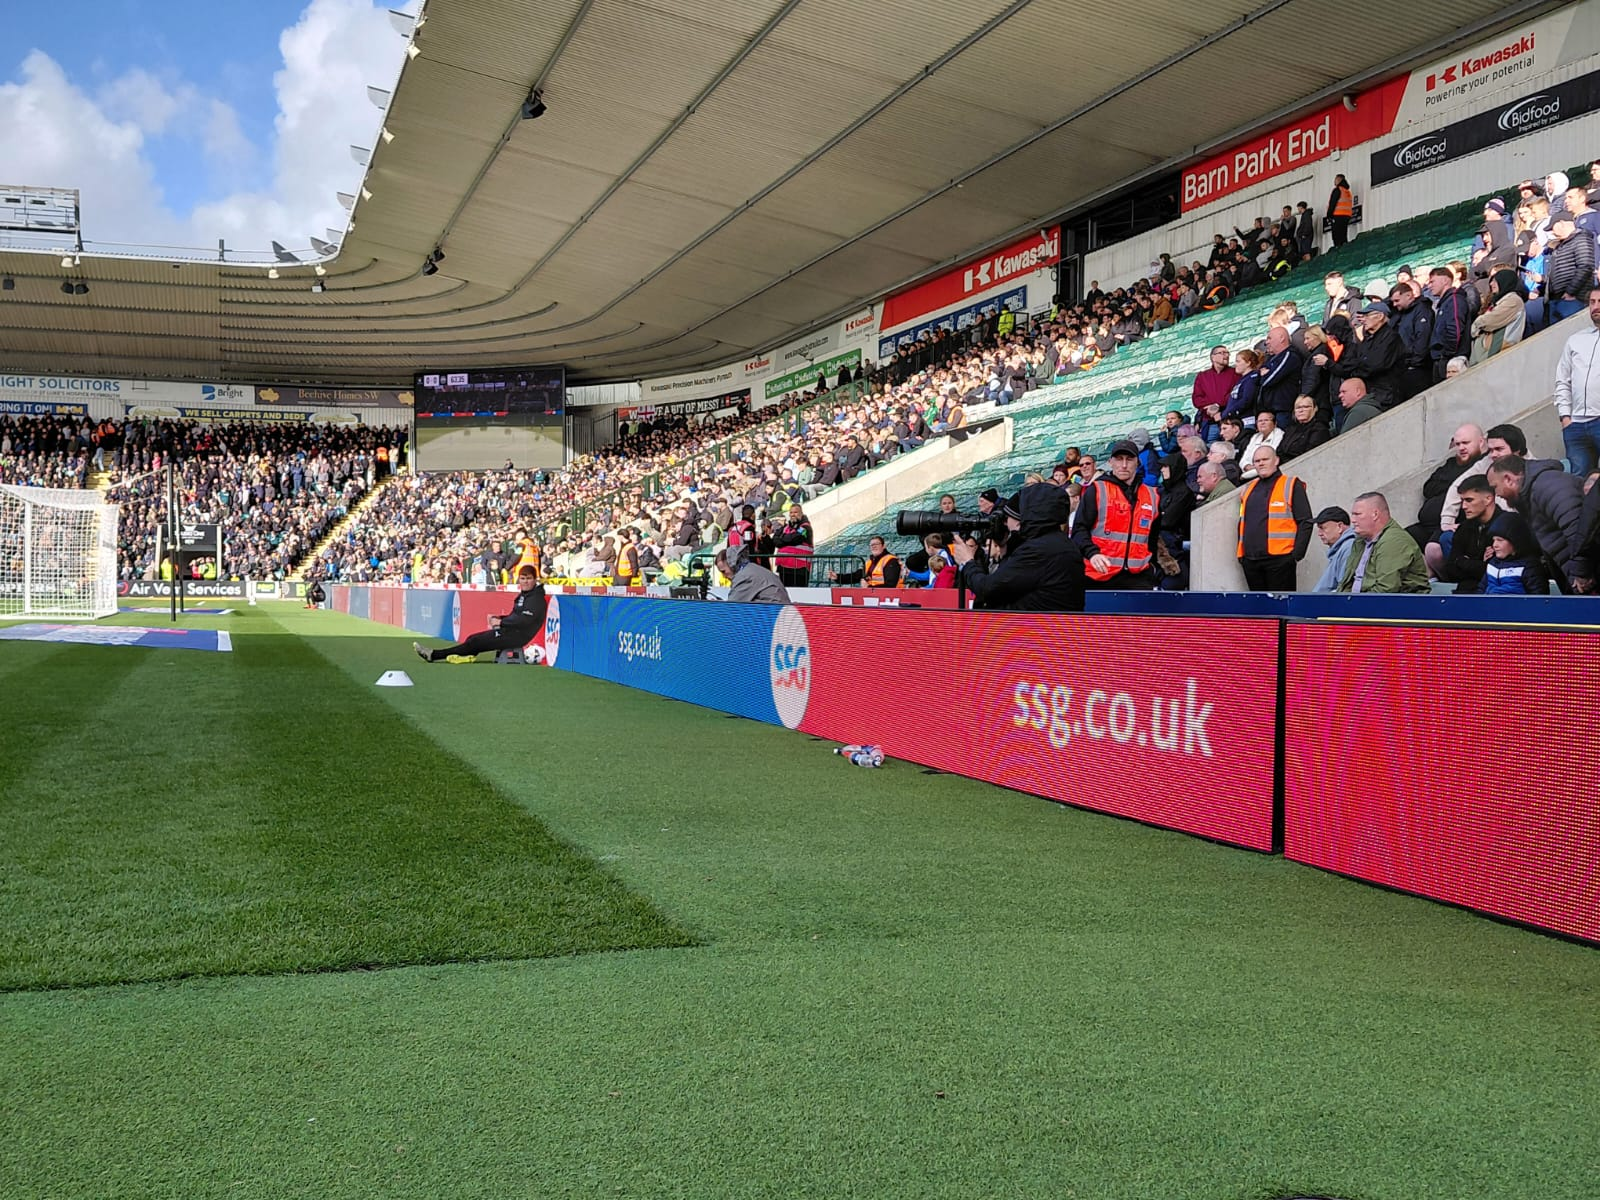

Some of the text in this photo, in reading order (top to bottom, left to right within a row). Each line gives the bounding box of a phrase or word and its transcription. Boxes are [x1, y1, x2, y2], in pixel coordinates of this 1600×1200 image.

[1462, 32, 1535, 77] Kawasaki
[1425, 55, 1535, 107] Powering your potential
[1511, 97, 1560, 127] Bidfood
[1185, 115, 1330, 203] Barn Park End
[1405, 138, 1447, 164] Bidfood
[994, 232, 1058, 280] Kawasaki
[39, 378, 120, 391] SOLICITORS
[218, 389, 243, 399] Bright
[299, 388, 378, 400] Beehive Homes SW
[23, 404, 33, 413] IT
[185, 409, 199, 417] WE
[222, 411, 261, 419] CARPETS
[671, 403, 684, 414] BIT
[685, 402, 695, 412] OF
[697, 398, 720, 412] MESSY
[130, 583, 150, 594] Air
[187, 583, 241, 595] Services
[618, 626, 662, 661] ssg.co.uk
[1014, 677, 1214, 757] ssg.co.uk
